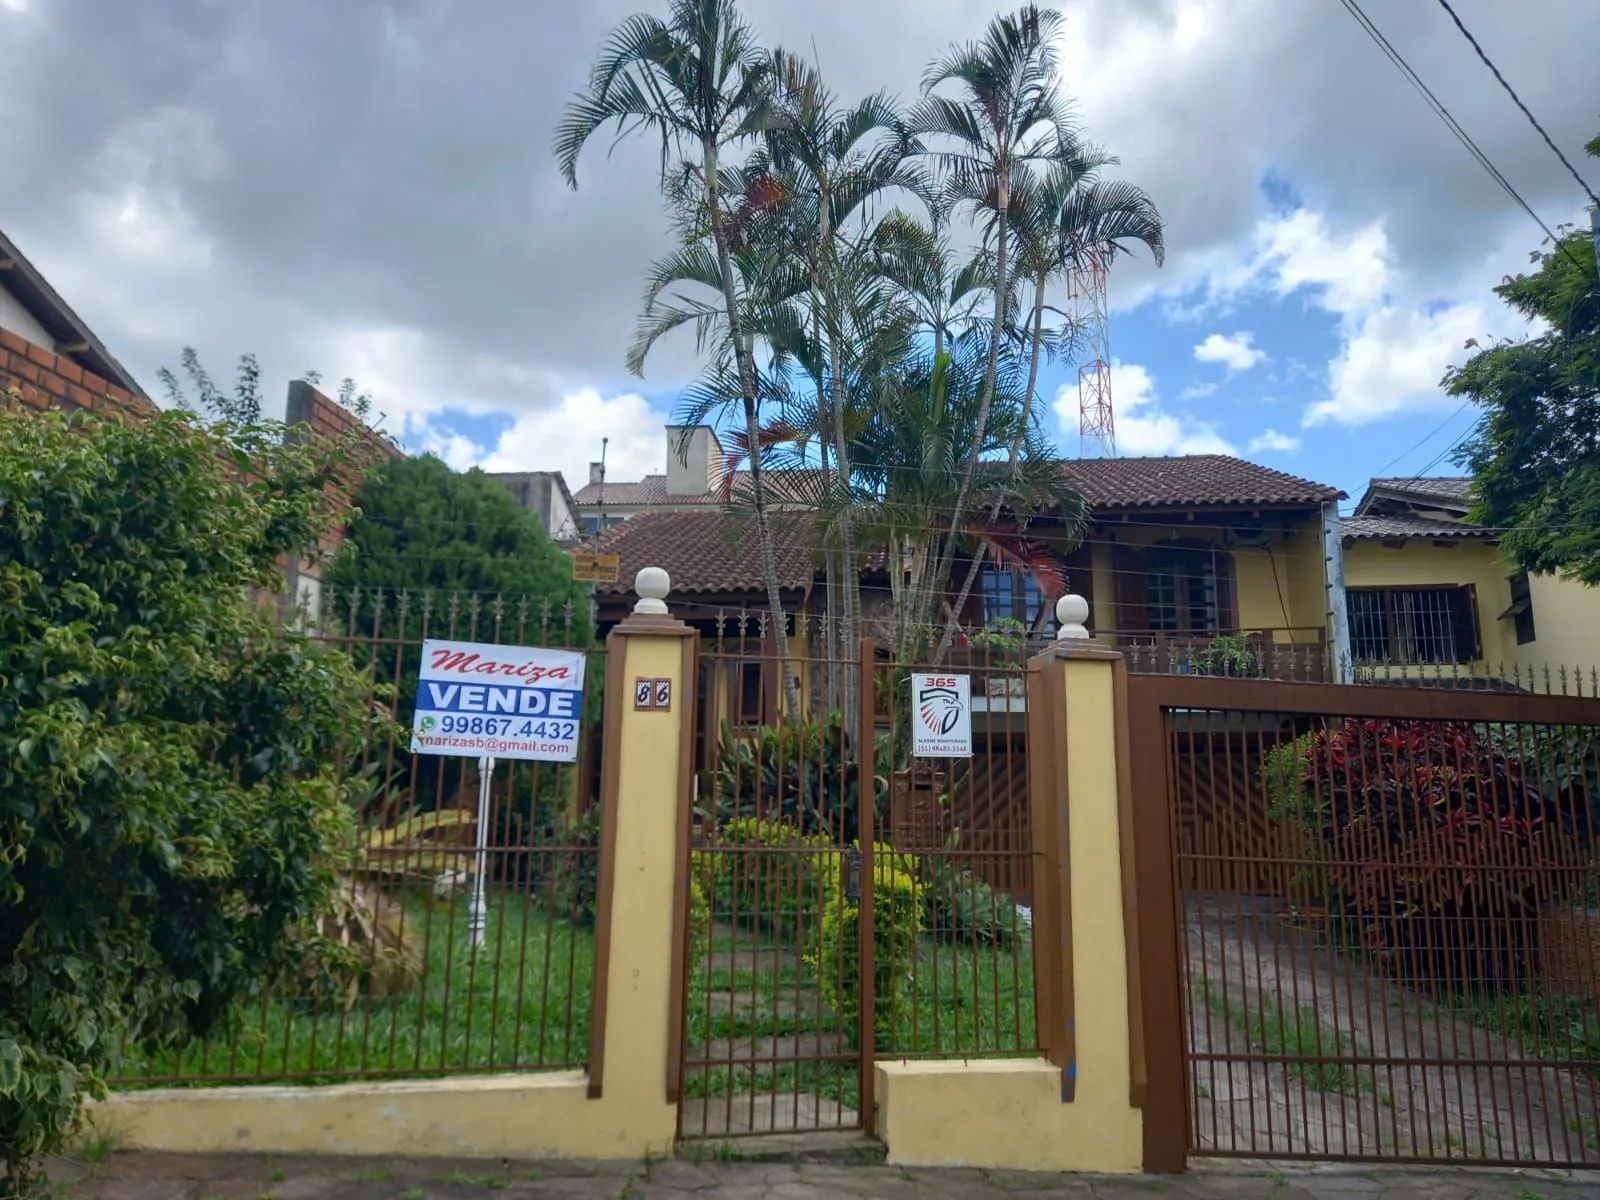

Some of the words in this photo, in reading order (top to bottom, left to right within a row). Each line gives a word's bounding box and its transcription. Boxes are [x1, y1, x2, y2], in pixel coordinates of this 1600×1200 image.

[432, 649, 570, 685] Mariza
[925, 677, 957, 687] 365
[428, 682, 574, 717] VENDE
[637, 684, 667, 702] 86
[441, 715, 575, 740] 99867.4432
[420, 736, 569, 753] marizasb@gmail.com
